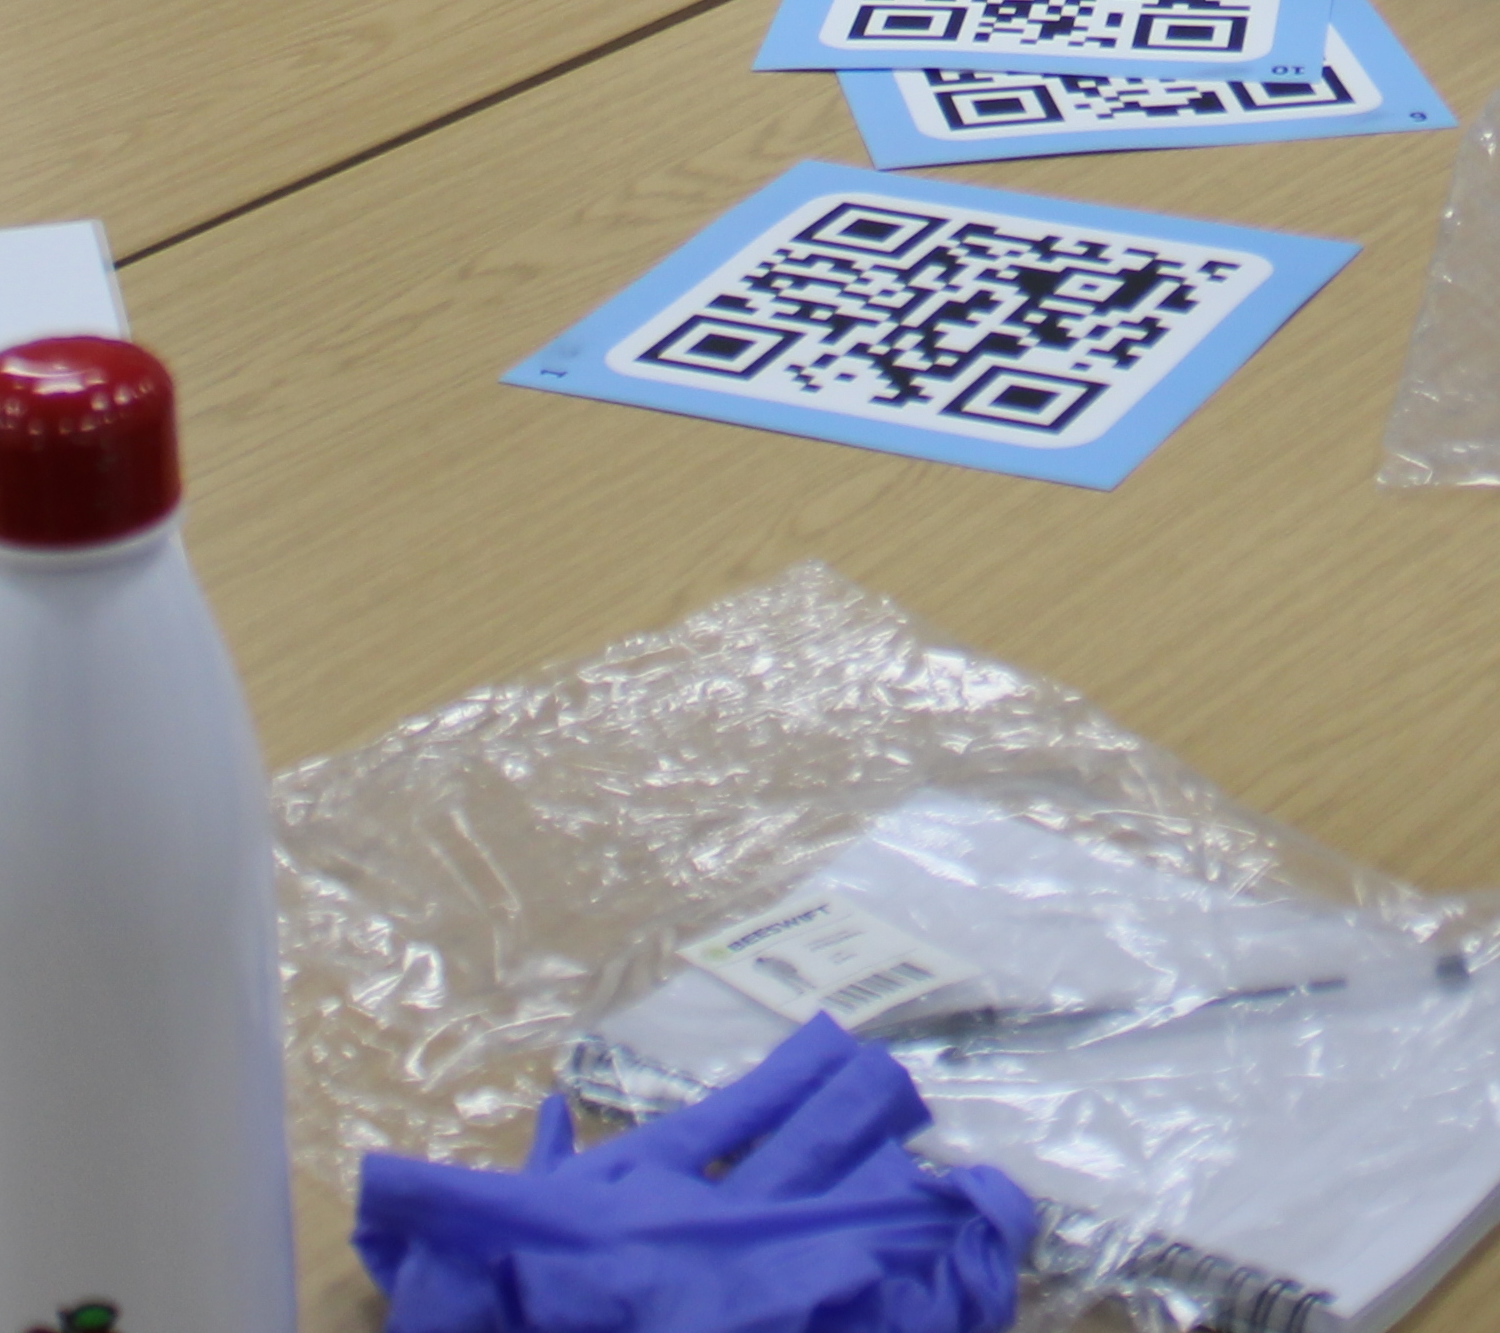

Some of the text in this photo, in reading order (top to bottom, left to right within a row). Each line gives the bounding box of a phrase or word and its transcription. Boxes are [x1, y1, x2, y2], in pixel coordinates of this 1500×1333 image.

[1271, 65, 1306, 75] 10
[1409, 111, 1428, 123] 6
[540, 368, 568, 378] 1
[726, 902, 831, 953] BEESWIFT
